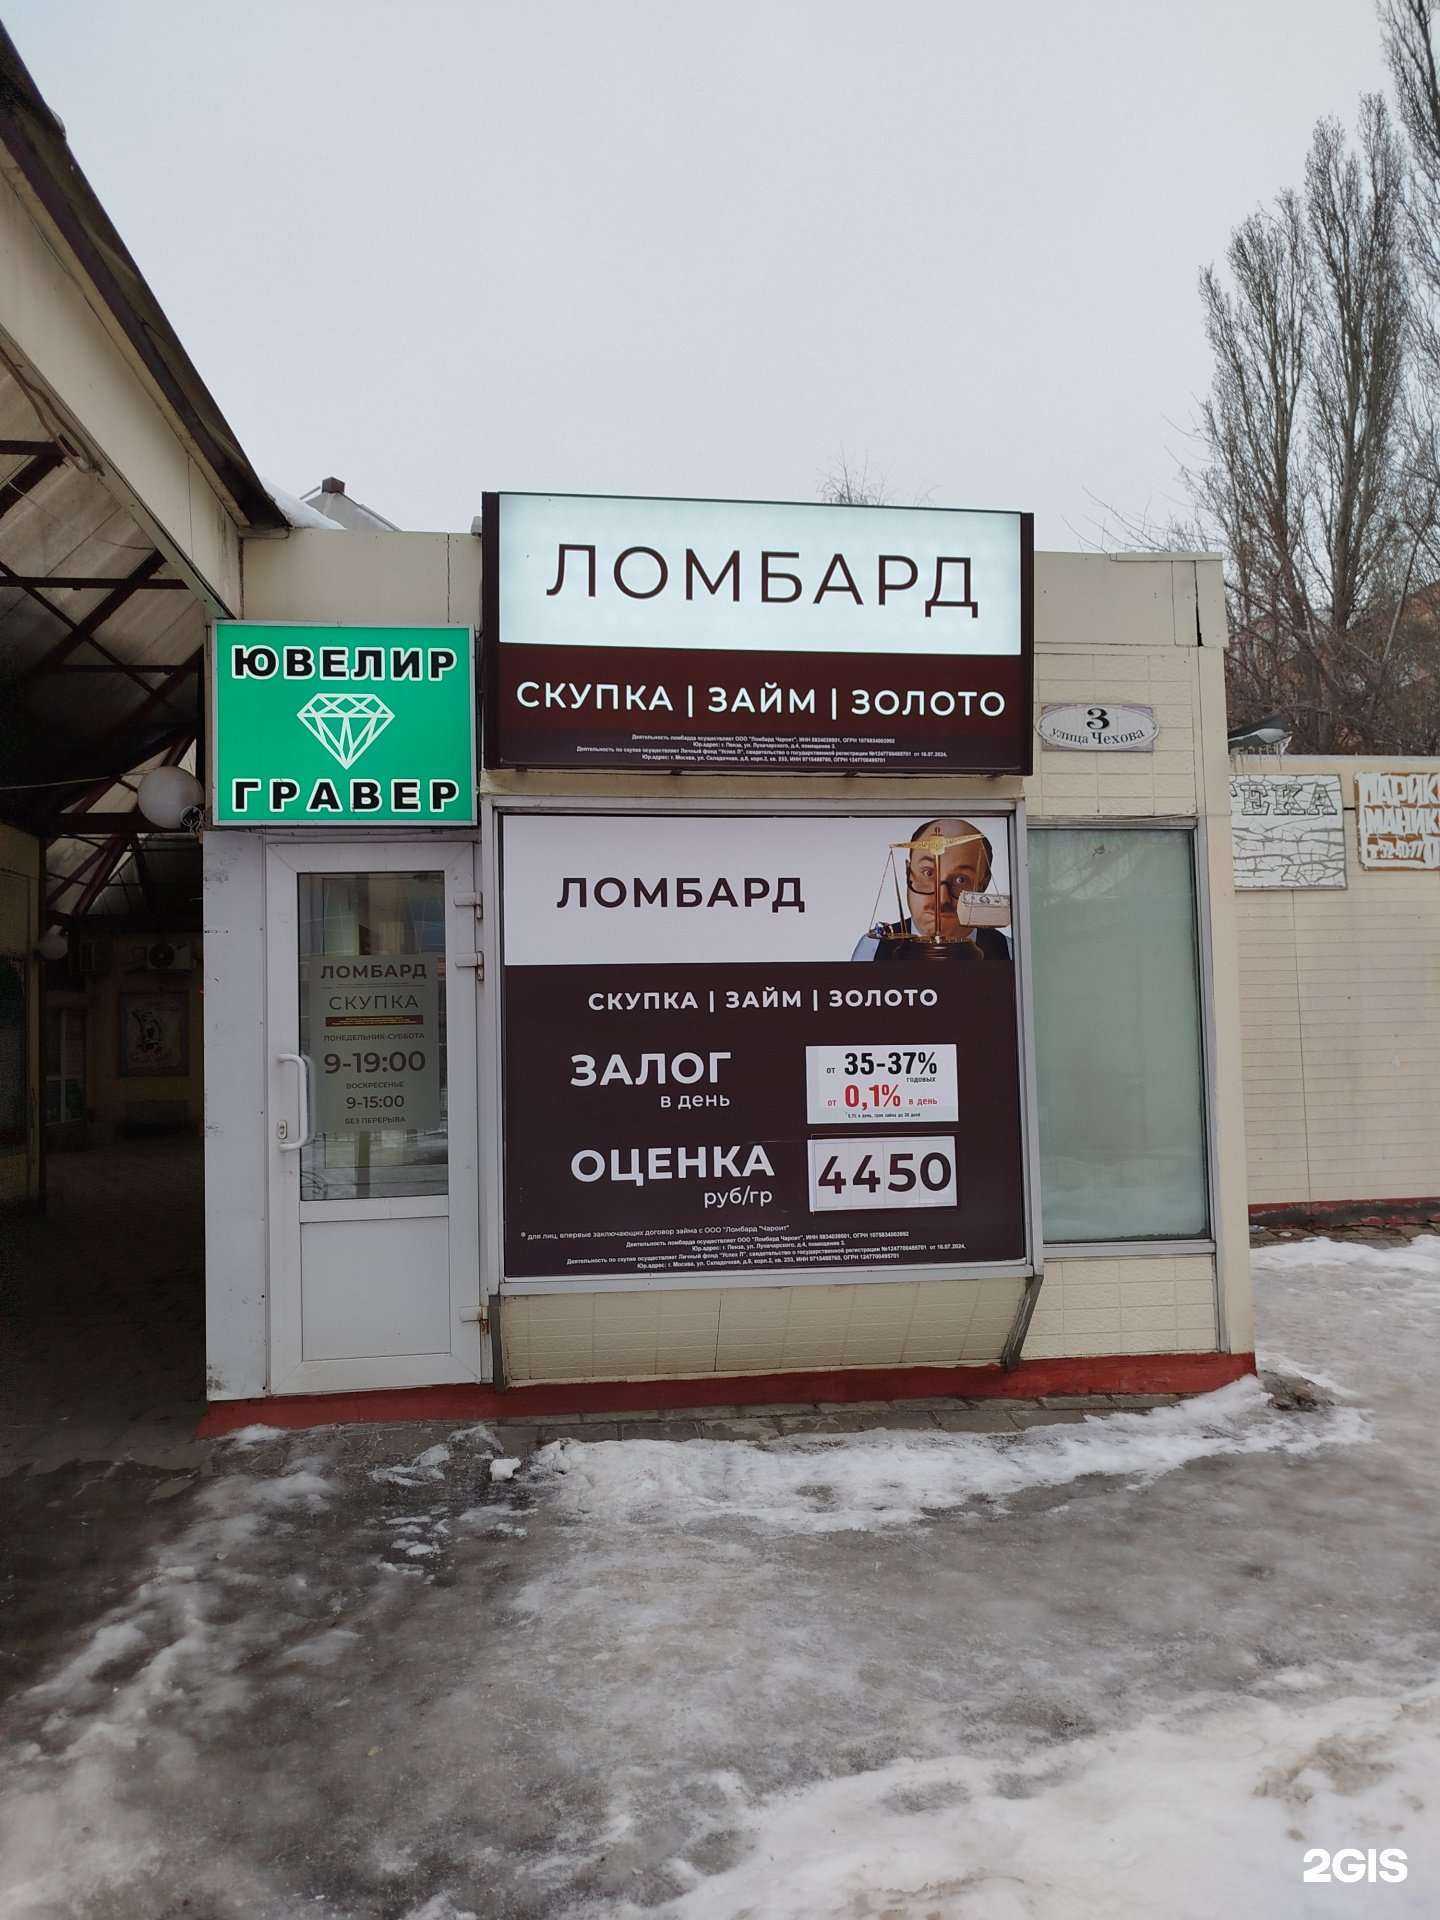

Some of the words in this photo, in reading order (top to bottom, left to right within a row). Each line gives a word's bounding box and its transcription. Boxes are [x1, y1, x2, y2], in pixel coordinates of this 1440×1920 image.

[546, 544, 979, 618] ЛОМБАРД
[232, 645, 457, 680] ЮВЕЛИР
[516, 681, 673, 711] СКУПКА
[708, 682, 816, 714] ЗАЙМ
[851, 689, 1006, 717] ЗОЛОТО
[1086, 707, 1110, 730] 3
[1050, 728, 1089, 744] улица
[1092, 729, 1145, 745] Чехова
[232, 778, 459, 813] ГРАВЕР
[556, 877, 806, 914] ЛОМБАРД
[320, 964, 427, 979] ЛОМБАРД
[329, 995, 419, 1010] СКУПКА
[588, 991, 699, 1012] СКУПКА
[725, 986, 802, 1009] ЗАЙМ
[829, 988, 939, 1009] ЗОЛОТО
[324, 1051, 425, 1074] 9-19:00
[570, 1051, 731, 1087] ЗАЛОГ
[844, 1052, 937, 1075] 35-37%
[346, 1081, 404, 1089] ВОСКРЕСЕНЬЕ
[346, 1095, 404, 1109] 9-15:00
[660, 1096, 671, 1108] в
[678, 1093, 730, 1110] день
[844, 1084, 901, 1111] 0,1%
[916, 1098, 938, 1106] день
[571, 1144, 775, 1187] ОЦЕНКА
[817, 1152, 952, 1195] 4450
[704, 1185, 772, 1208] руб/гр
